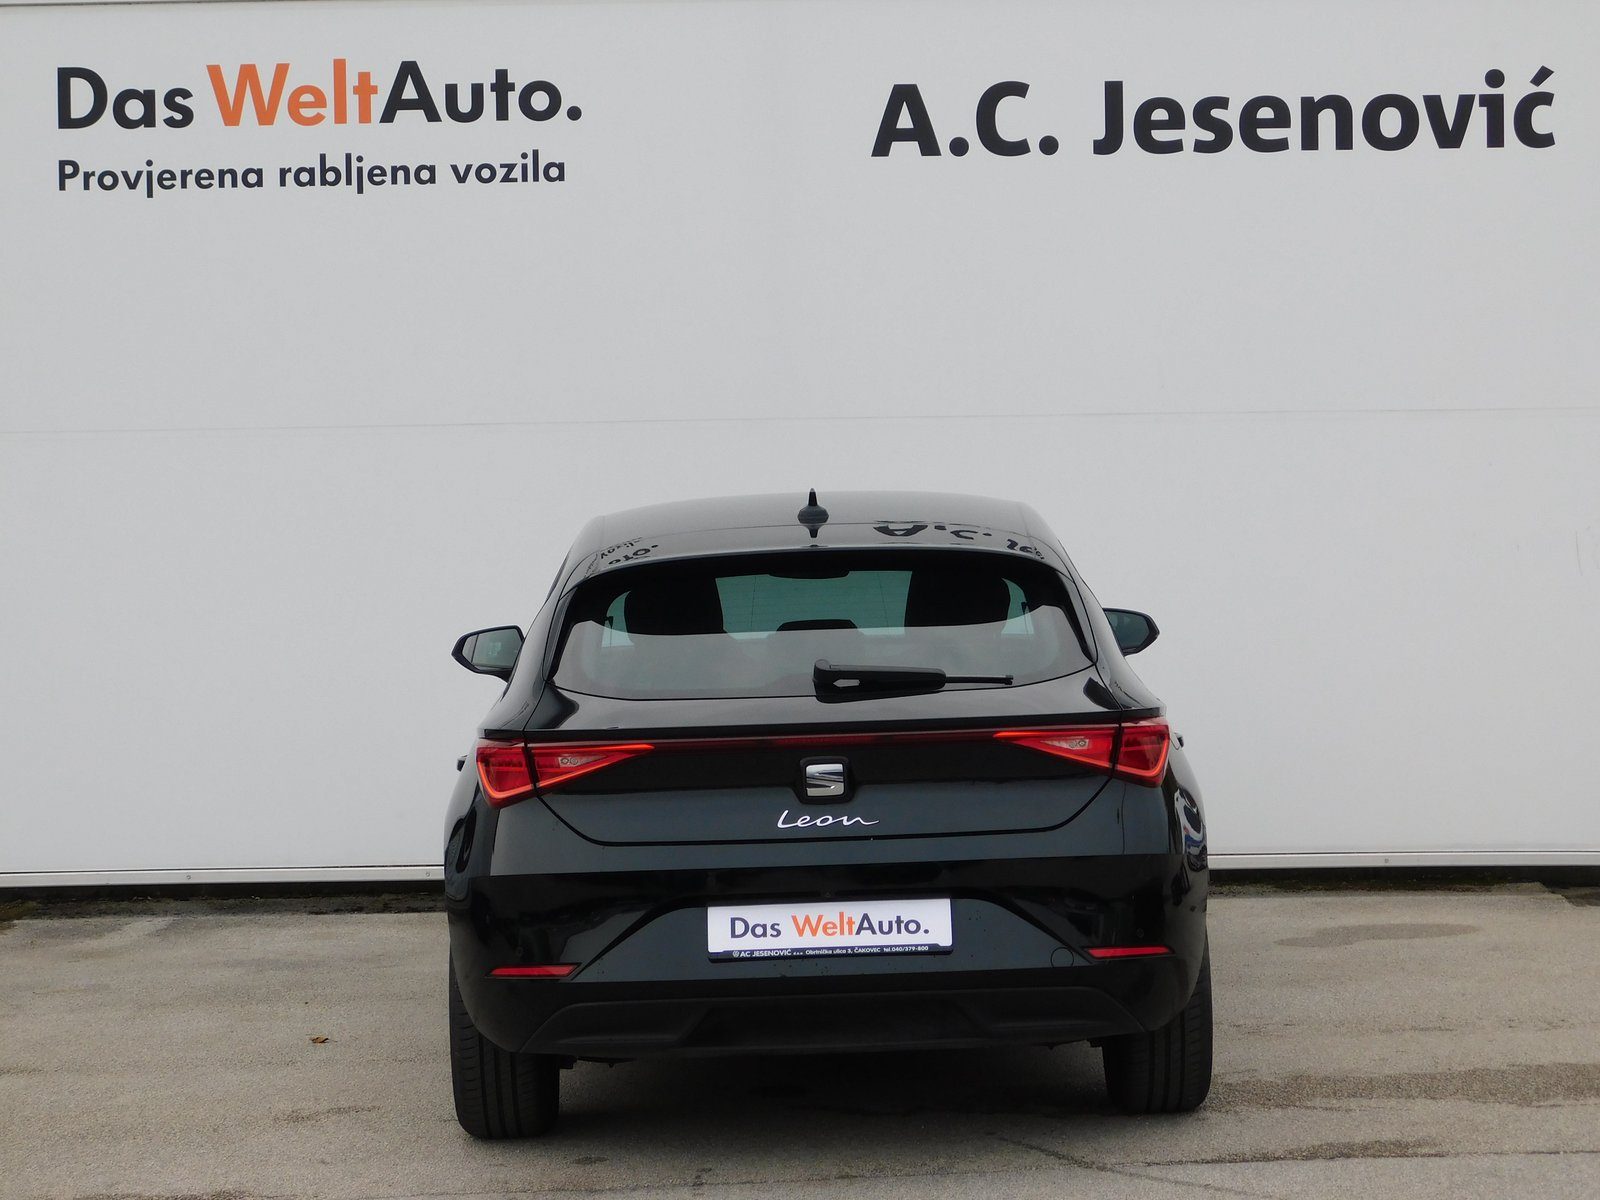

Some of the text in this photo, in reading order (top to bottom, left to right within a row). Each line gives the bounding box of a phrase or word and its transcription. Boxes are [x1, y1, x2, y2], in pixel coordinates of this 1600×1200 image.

[57, 59, 582, 129] Das WeltAuto.
[871, 65, 1556, 157] A.C. Jesenović
[58, 148, 565, 199] Provjerena rabljena vozila
[777, 809, 880, 829] Leon
[730, 911, 929, 939] Das WeltAuto.
